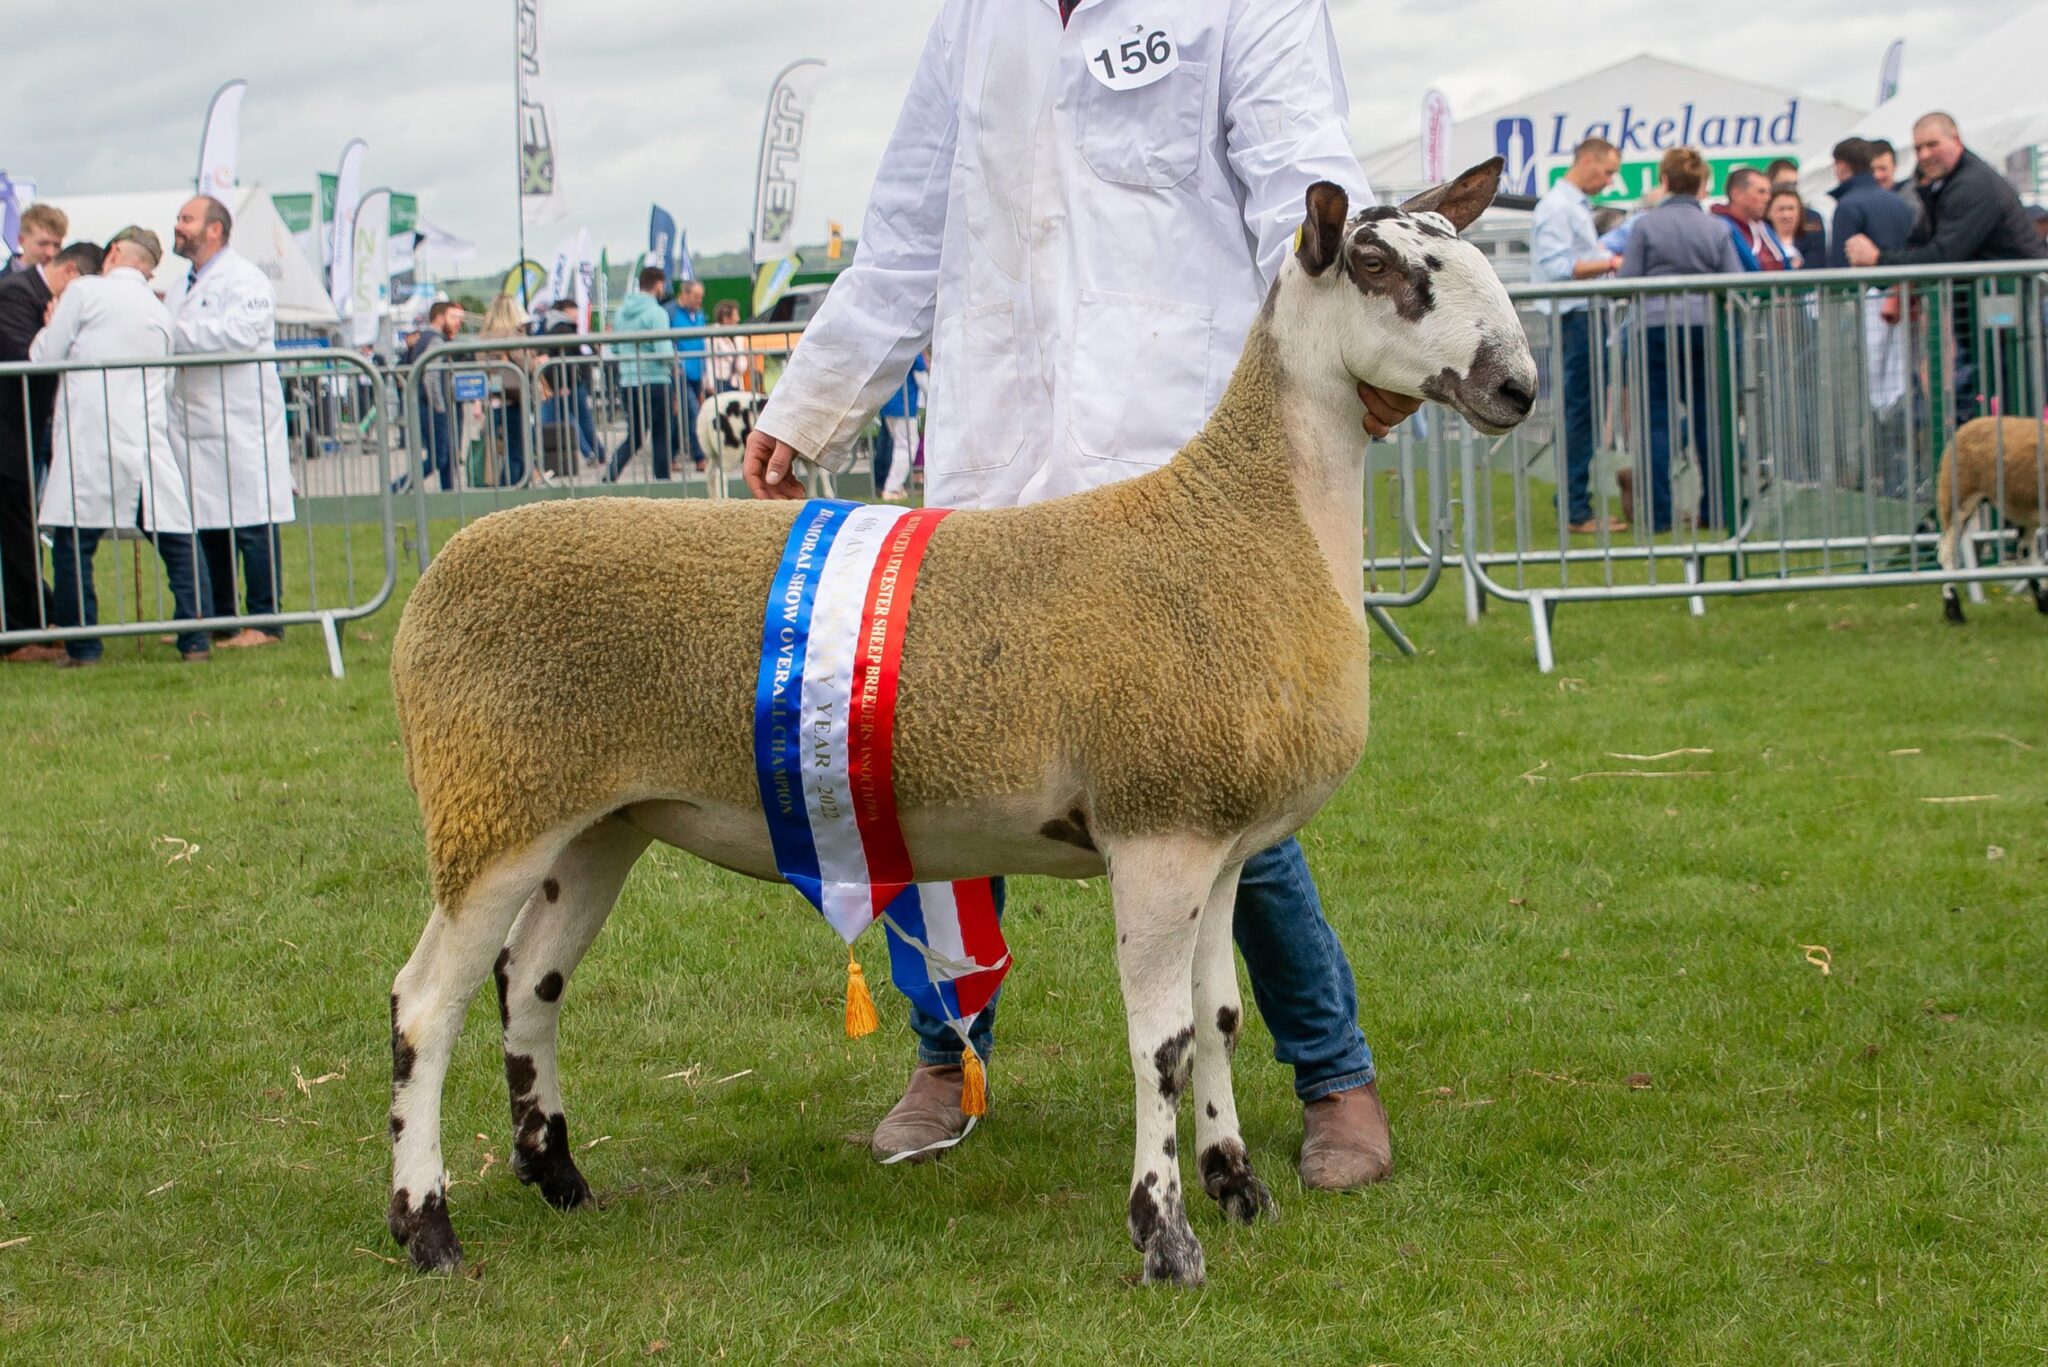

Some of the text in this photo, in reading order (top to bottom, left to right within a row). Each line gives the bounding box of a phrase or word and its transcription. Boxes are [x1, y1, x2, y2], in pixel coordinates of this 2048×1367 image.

[1094, 30, 1171, 79] 156
[762, 84, 805, 241] JALEX
[874, 553, 904, 616] LEICESTER
[771, 508, 835, 814] BALMORAL SHOW OVERALL CHAMPION
[867, 618, 888, 664] SHEEP
[814, 702, 833, 768] YEAR
[860, 665, 881, 741] BREEDERS
[816, 785, 840, 819] 2022
[861, 747, 879, 821] ASSOCIATION
